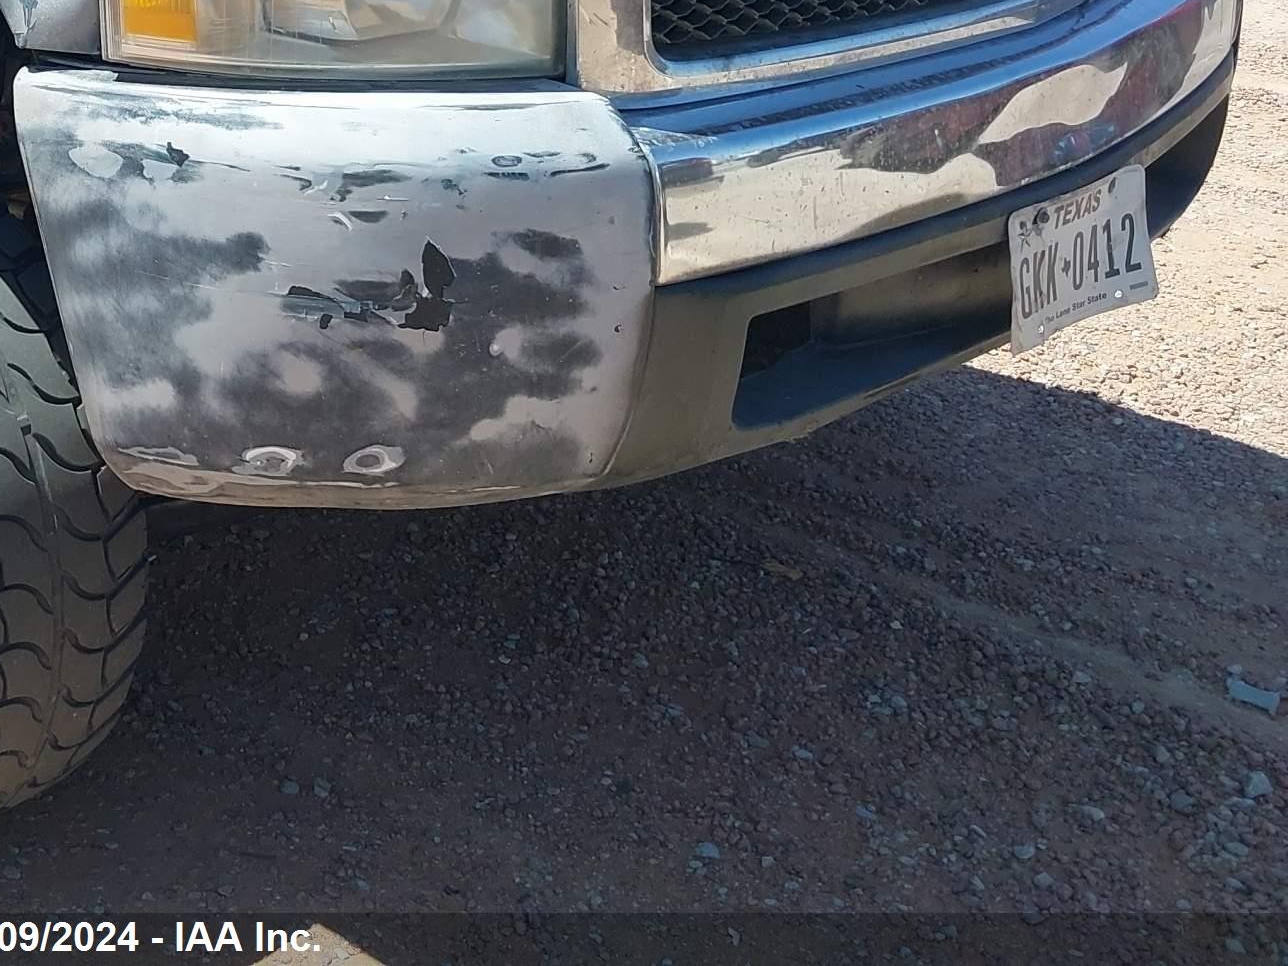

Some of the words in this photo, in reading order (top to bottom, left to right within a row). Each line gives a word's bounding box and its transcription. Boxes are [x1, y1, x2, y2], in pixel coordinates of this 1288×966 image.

[1054, 189, 1101, 230] TEXAS
[1055, 306, 1071, 320] Lone
[1071, 301, 1087, 312] Star
[1087, 292, 1107, 305] State
